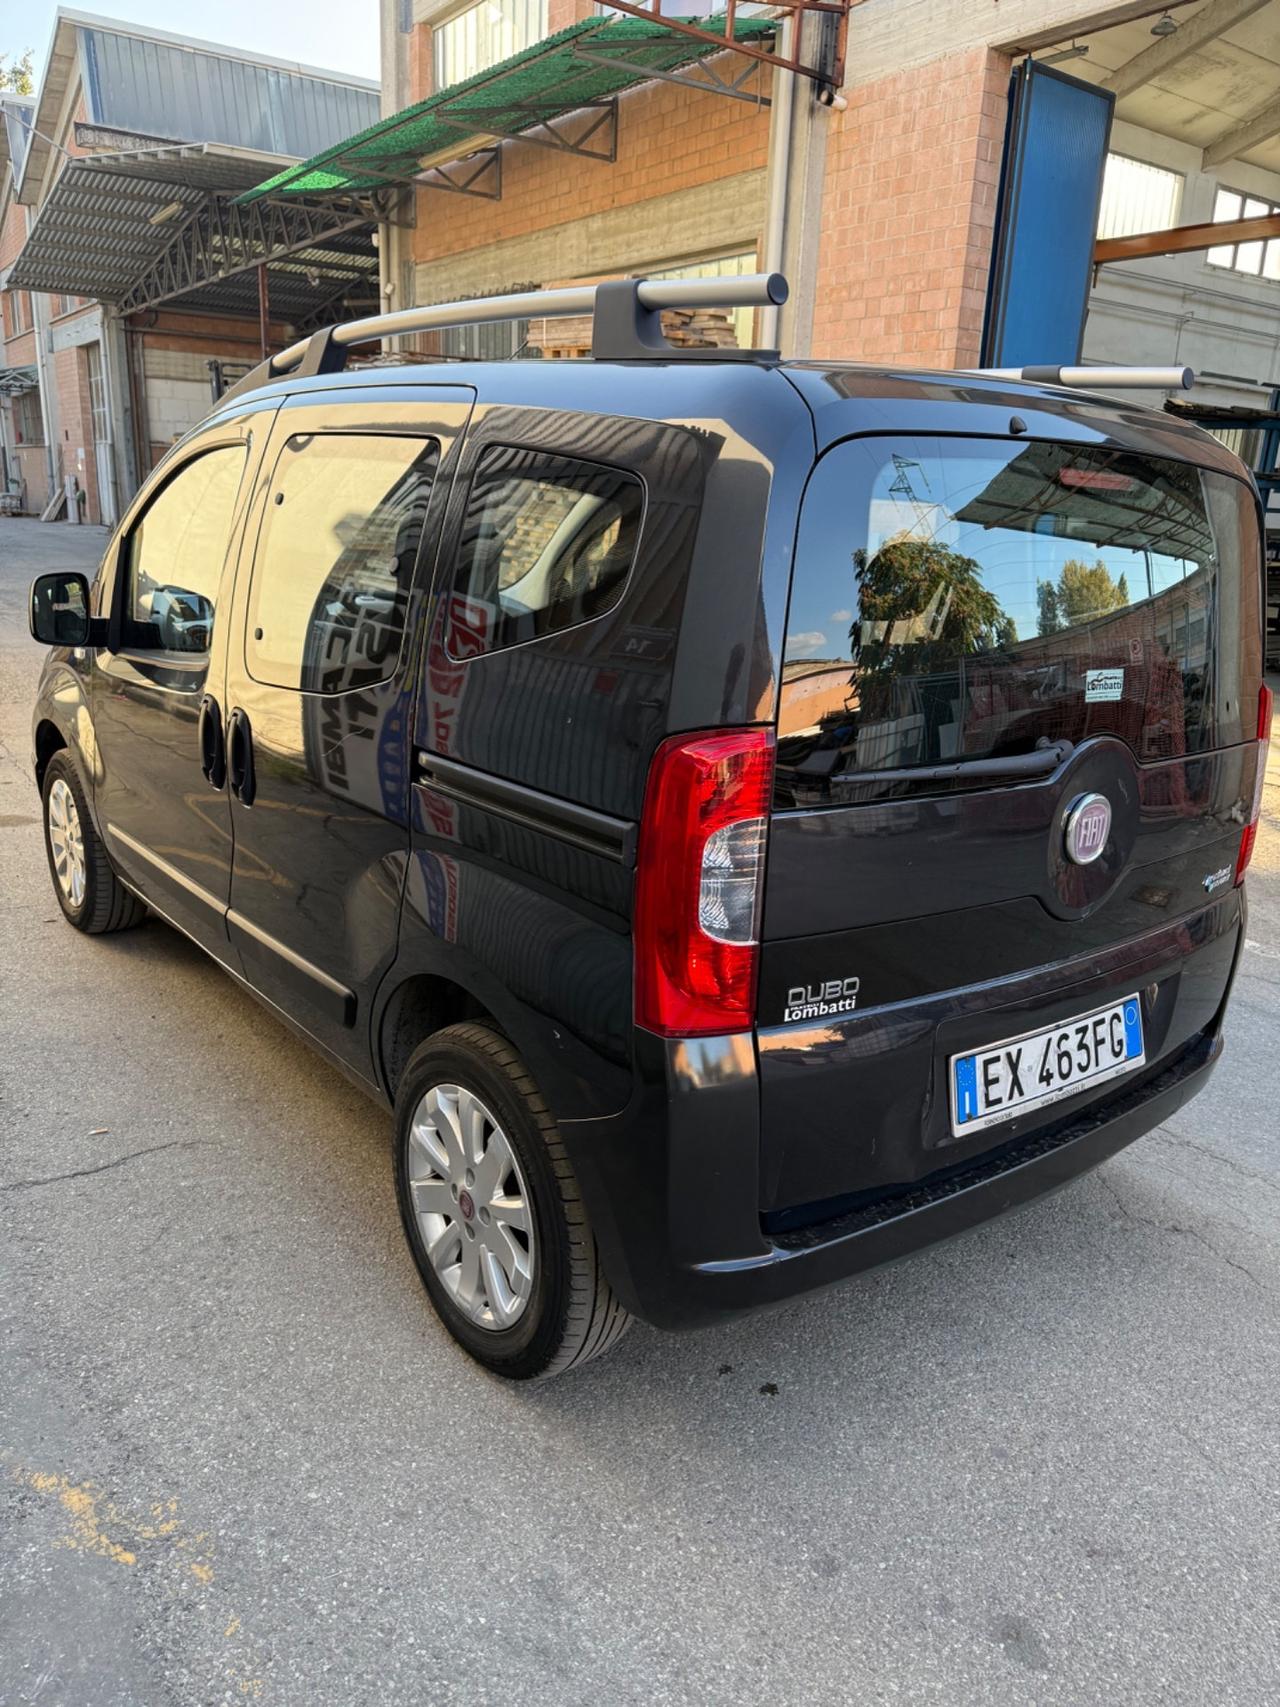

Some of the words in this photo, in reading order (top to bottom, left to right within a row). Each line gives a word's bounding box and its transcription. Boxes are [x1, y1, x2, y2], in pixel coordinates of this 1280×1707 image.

[1079, 814, 1106, 850] FIAT
[788, 977, 859, 1006] QUBO
[784, 996, 856, 1022] Lombatti
[982, 1048, 1025, 1108] EX
[1038, 1012, 1124, 1088] 463FG
